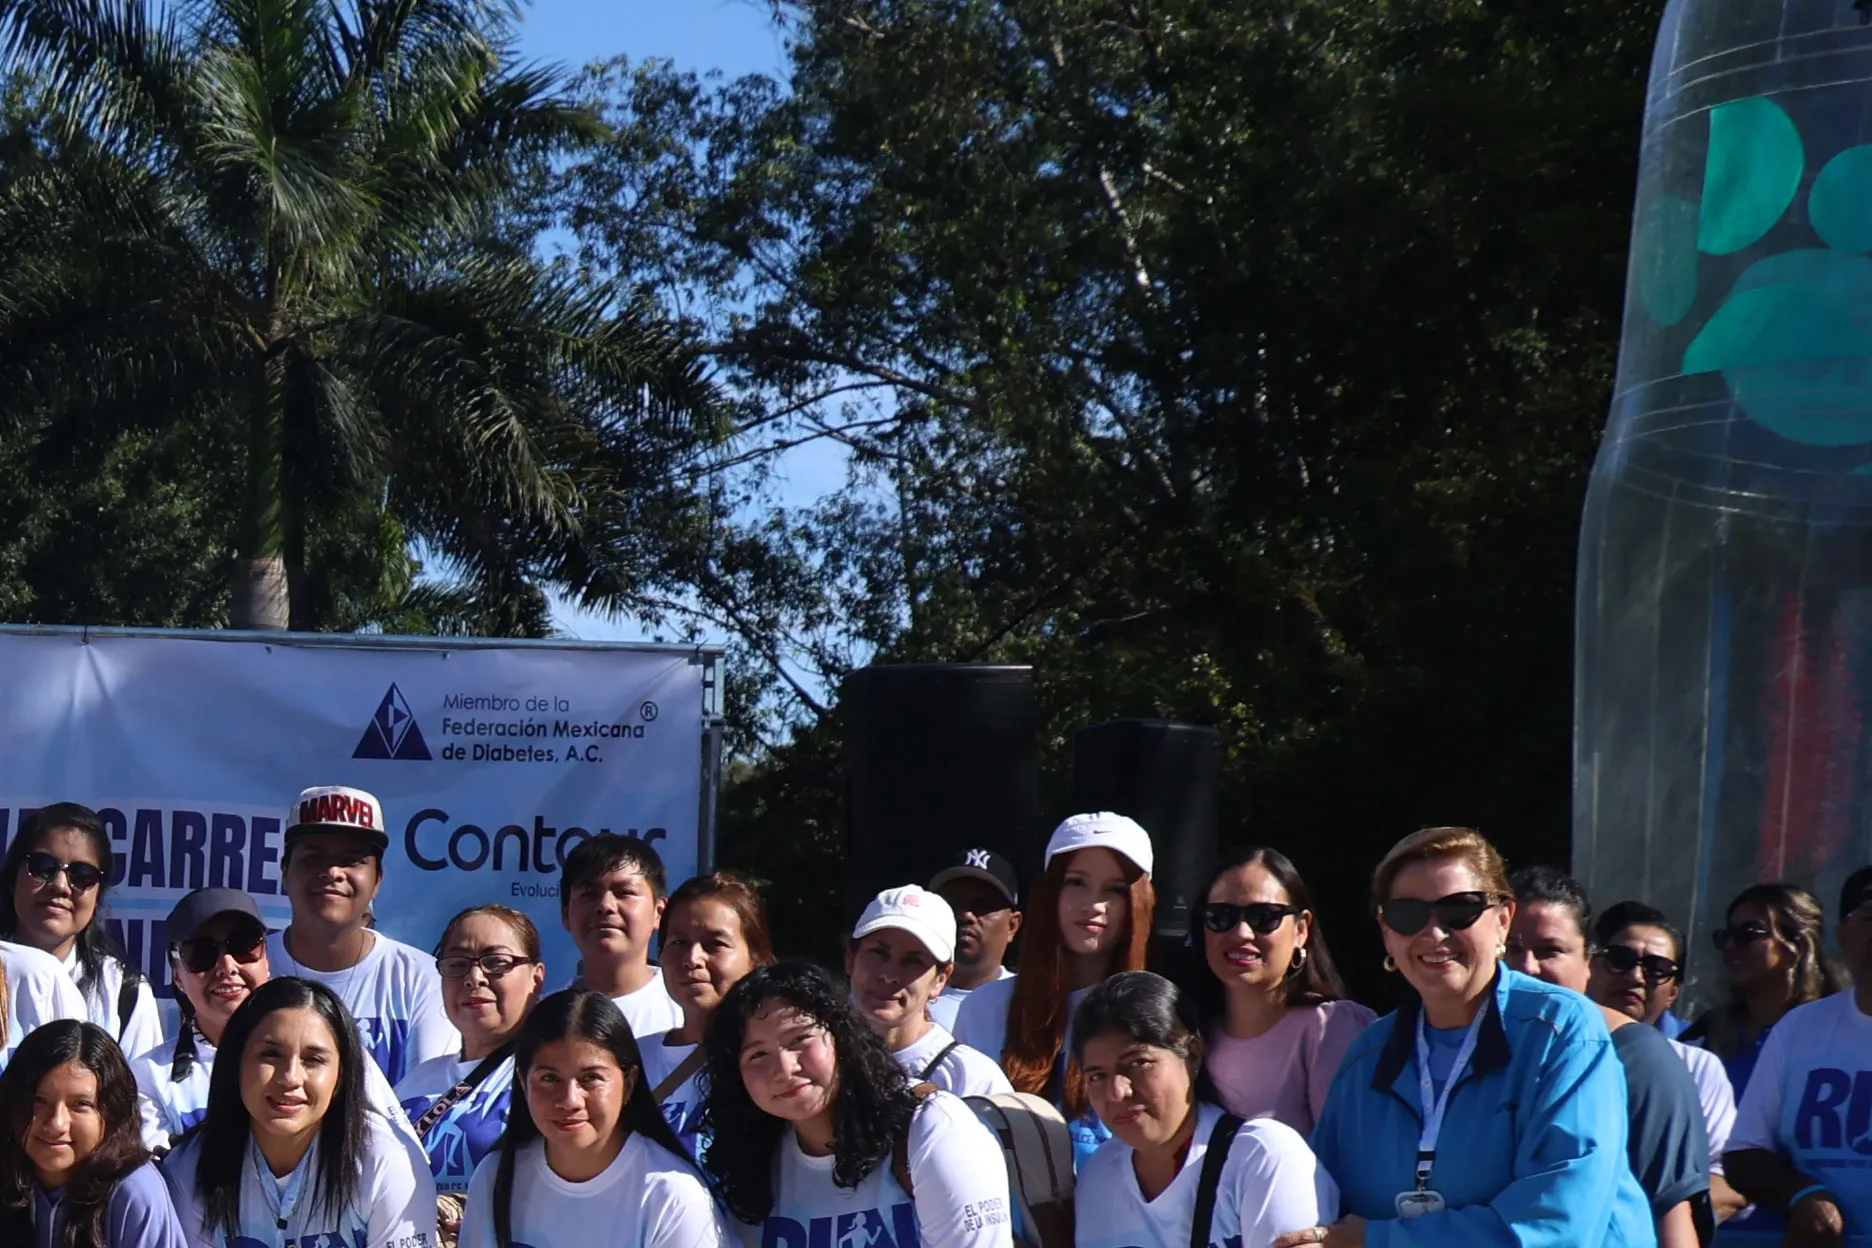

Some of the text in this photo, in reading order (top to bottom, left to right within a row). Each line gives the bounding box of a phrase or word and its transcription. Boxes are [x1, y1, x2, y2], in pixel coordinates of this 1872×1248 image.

[443, 693, 569, 712] Miembro de la
[442, 717, 547, 738] Federación
[552, 719, 645, 738] Mexicana
[442, 743, 603, 763] de Diabetes, A.C.
[404, 808, 667, 874] Contor
[95, 808, 288, 896] CARRE
[511, 881, 560, 897] Evoluci
